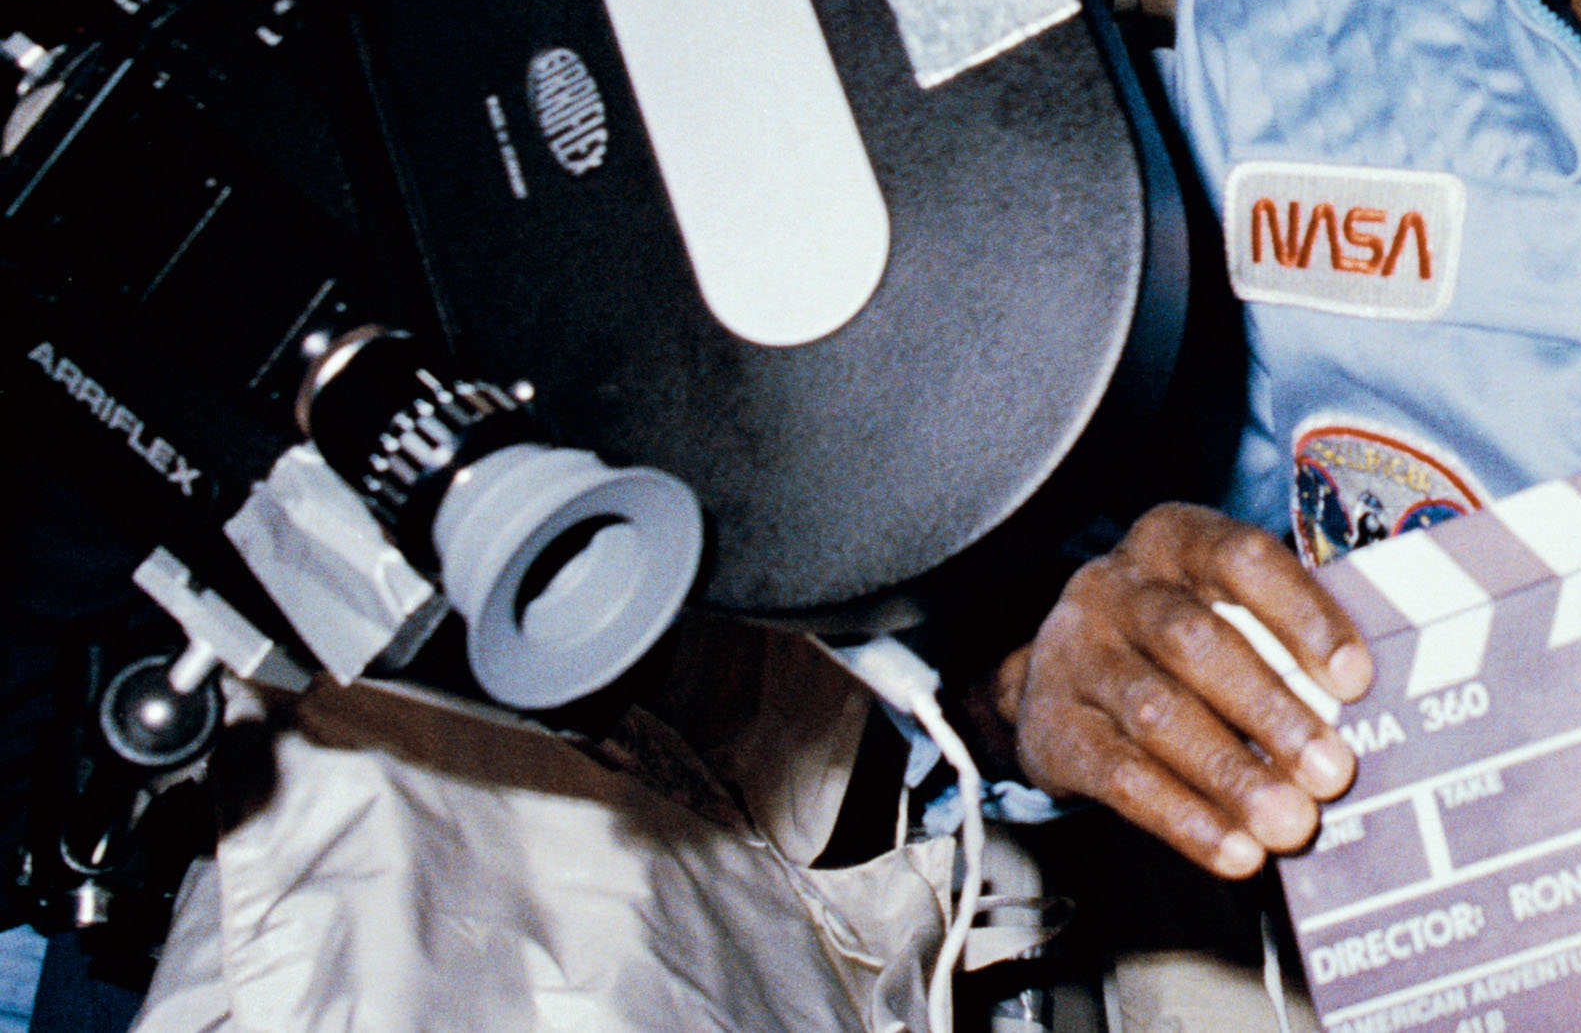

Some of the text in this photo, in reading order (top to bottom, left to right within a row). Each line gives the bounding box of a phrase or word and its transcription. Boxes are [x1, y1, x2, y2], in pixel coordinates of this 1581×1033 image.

[526, 47, 609, 177] ARRIFLEX
[1250, 196, 1434, 281] NASA
[28, 341, 201, 496] ARRIFLEX
[1338, 682, 1490, 758] MA 360
[1435, 769, 1505, 809] TAKE
[1308, 901, 1486, 986] DIRECTOR:
